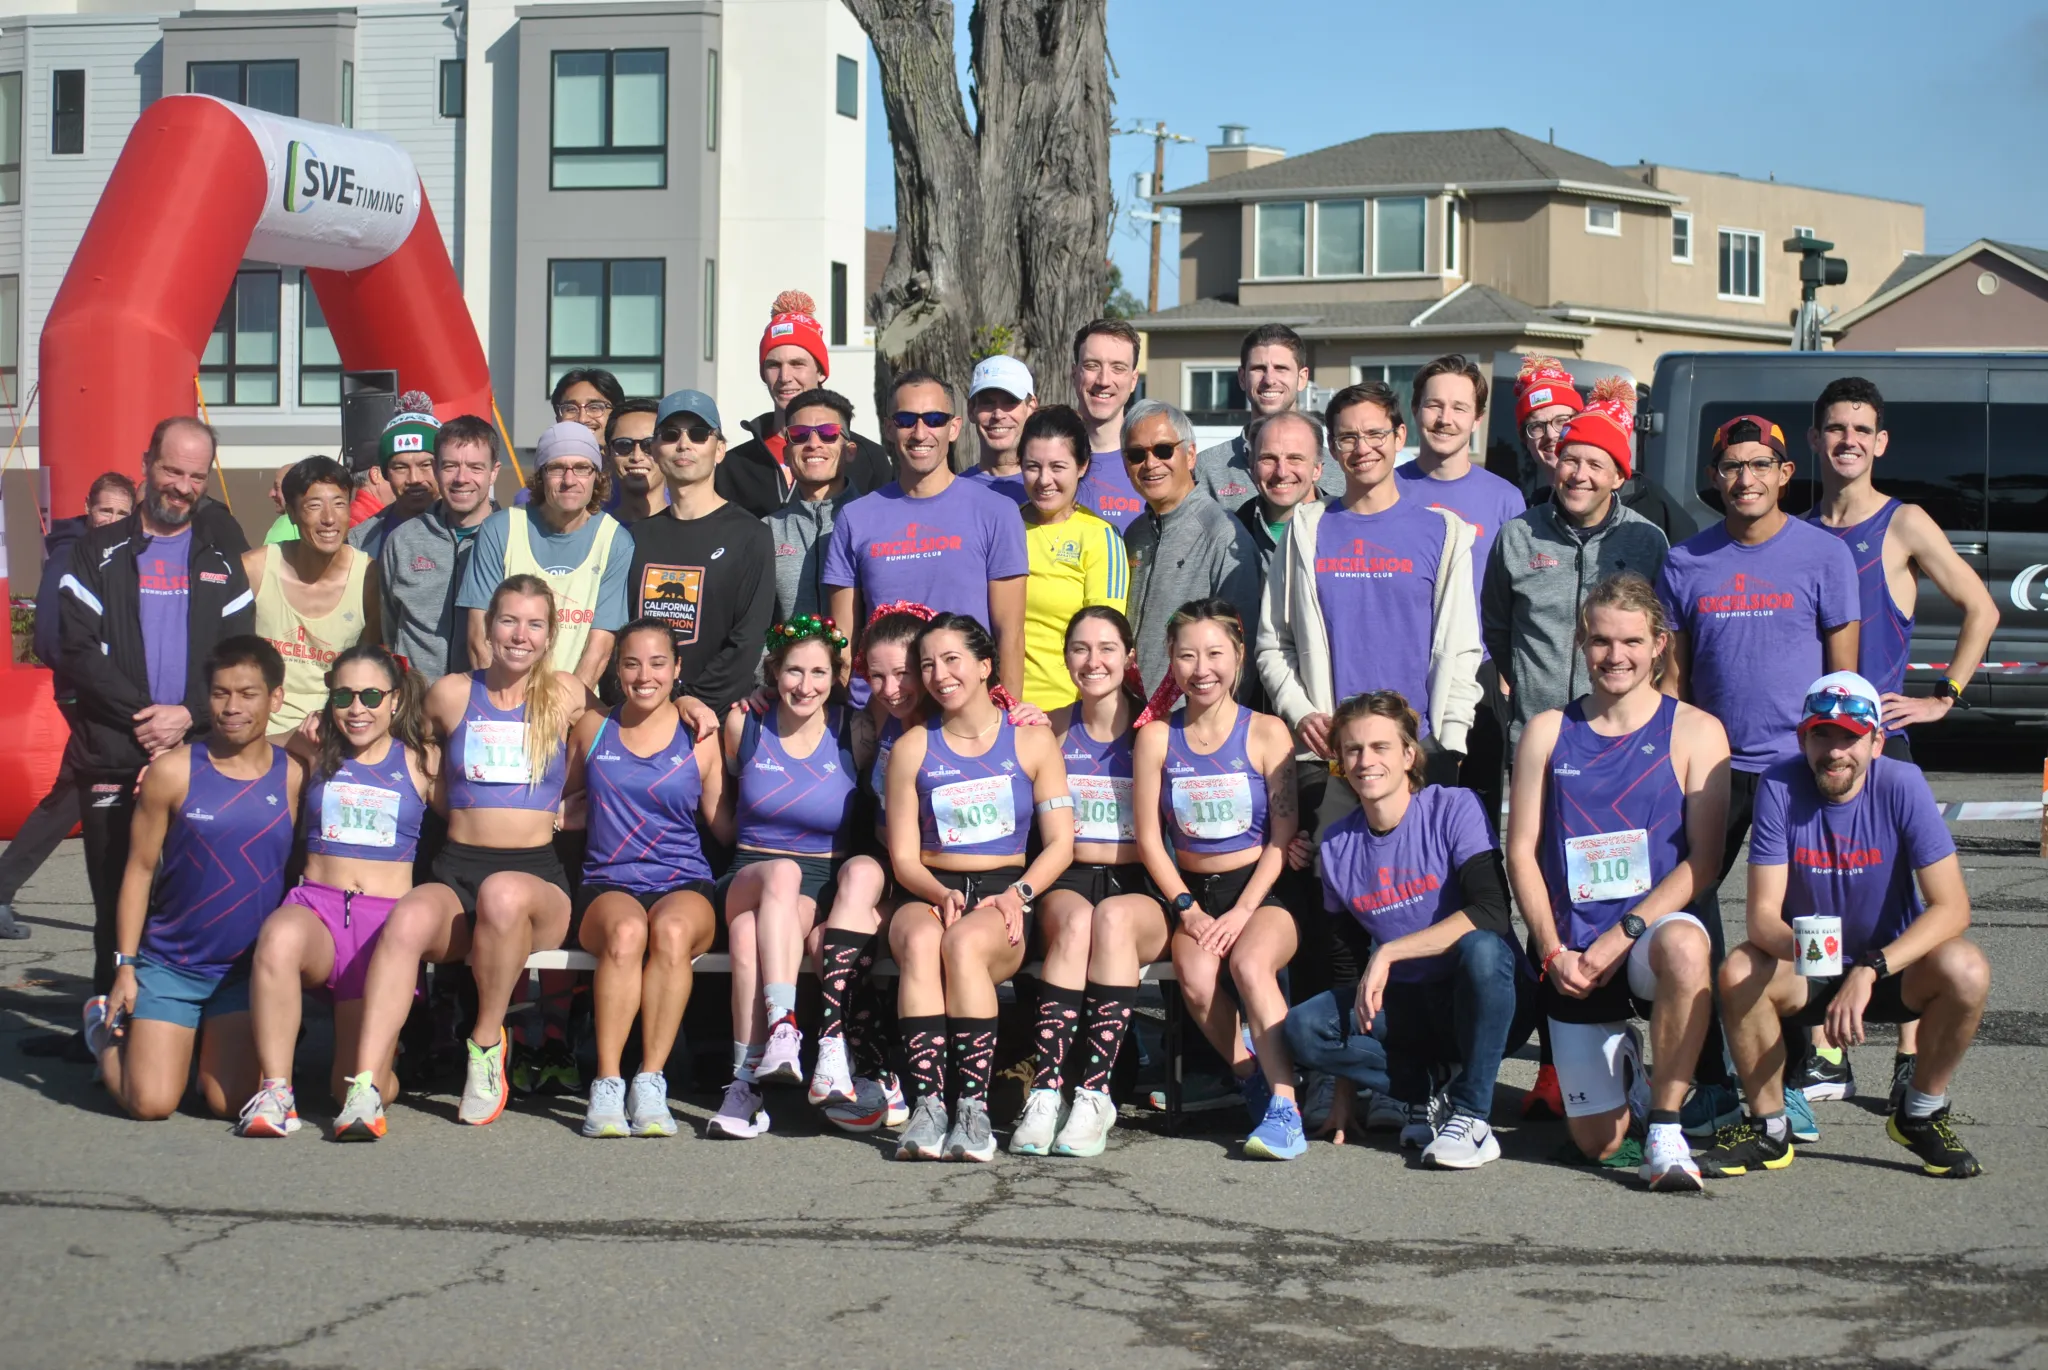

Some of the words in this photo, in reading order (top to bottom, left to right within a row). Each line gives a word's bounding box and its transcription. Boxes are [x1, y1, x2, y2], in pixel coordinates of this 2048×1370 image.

[302, 158, 355, 205] SVE
[355, 185, 404, 215] TIMING
[870, 535, 962, 558] EXCELSIOR
[885, 553, 921, 562] RUNNING
[923, 551, 942, 559] CLUB
[661, 571, 687, 582] 26.2
[1315, 556, 1414, 574] EXCELSIOR
[643, 601, 696, 613] CALIFORNIA
[1697, 592, 1794, 614] EXCELSIOR
[1715, 610, 1751, 619] RUNNING
[643, 610, 695, 620] INTERNATIONAL
[667, 618, 694, 629] THON
[264, 637, 343, 664] XCELSIO
[486, 745, 522, 768] 117
[341, 805, 378, 830] 117
[953, 803, 998, 829] 109
[1080, 800, 1121, 823] 109
[1192, 800, 1234, 823] 118
[1590, 858, 1629, 884] 110
[1352, 873, 1440, 914] EXCELSIOR
[1371, 901, 1404, 916] RUNNING
[1405, 895, 1424, 905] CLUB
